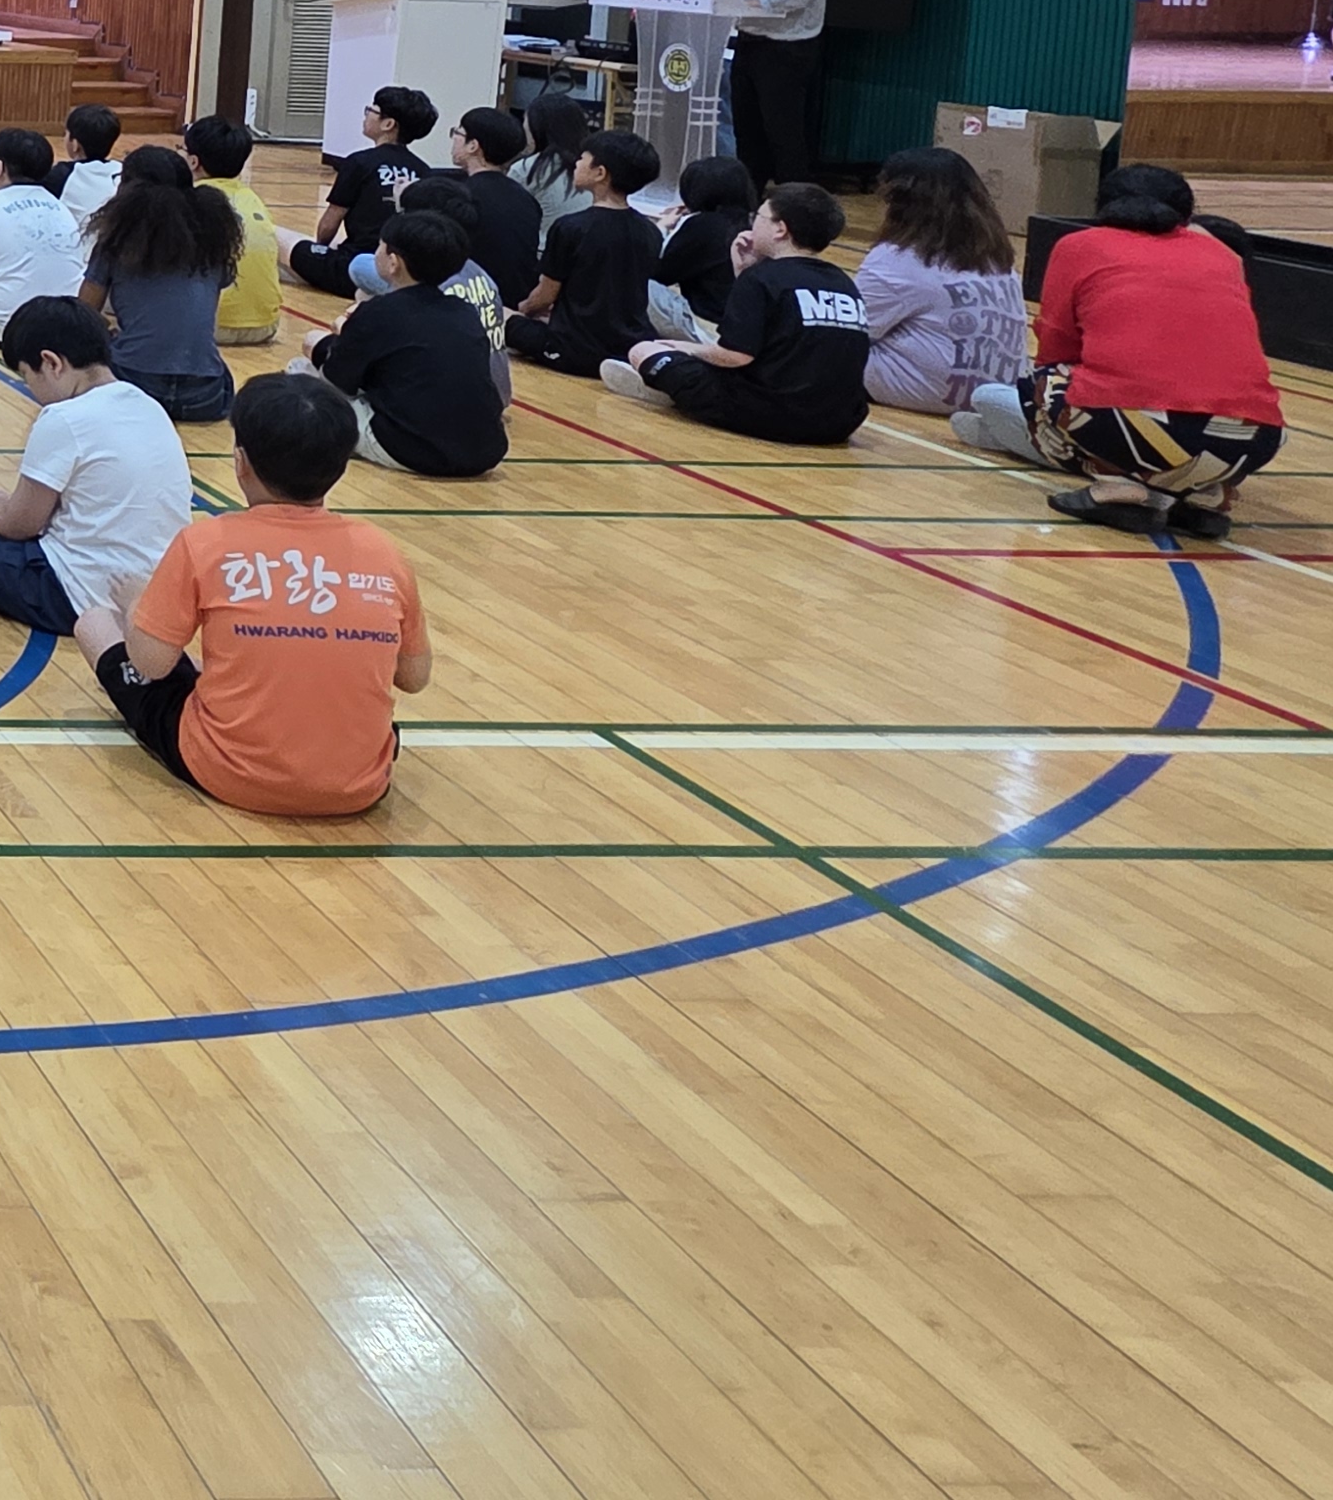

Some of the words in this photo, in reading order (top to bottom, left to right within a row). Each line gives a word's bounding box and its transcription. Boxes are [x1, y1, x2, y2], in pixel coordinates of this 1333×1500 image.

[220, 549, 341, 615] 화랑
[347, 572, 396, 593] 합기도
[234, 624, 328, 640] HWARANG
